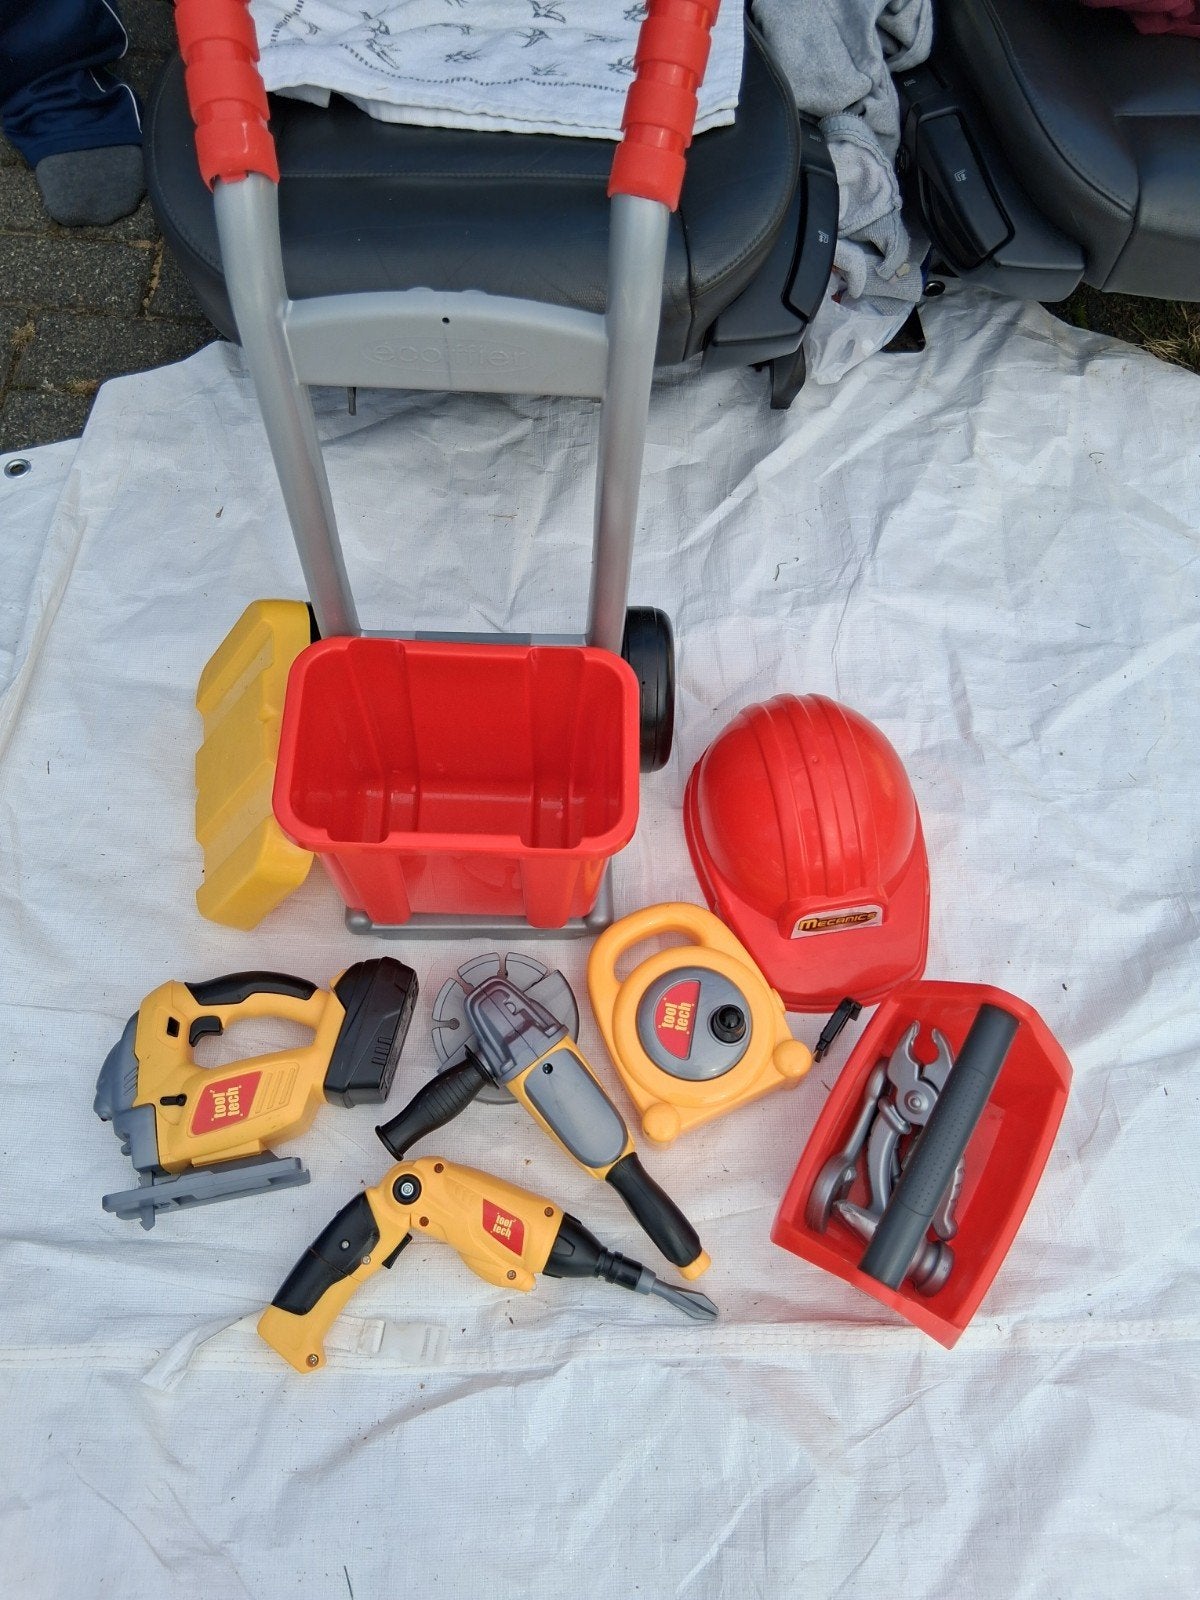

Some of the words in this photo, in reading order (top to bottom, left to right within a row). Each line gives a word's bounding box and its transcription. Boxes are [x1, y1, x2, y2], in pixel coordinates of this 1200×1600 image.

[661, 1002, 678, 1029] tool
[674, 1002, 692, 1031] tech
[212, 1092, 227, 1119] tool
[226, 1086, 240, 1117] tech
[492, 1223, 512, 1239] tech
[495, 1214, 513, 1229] tool
